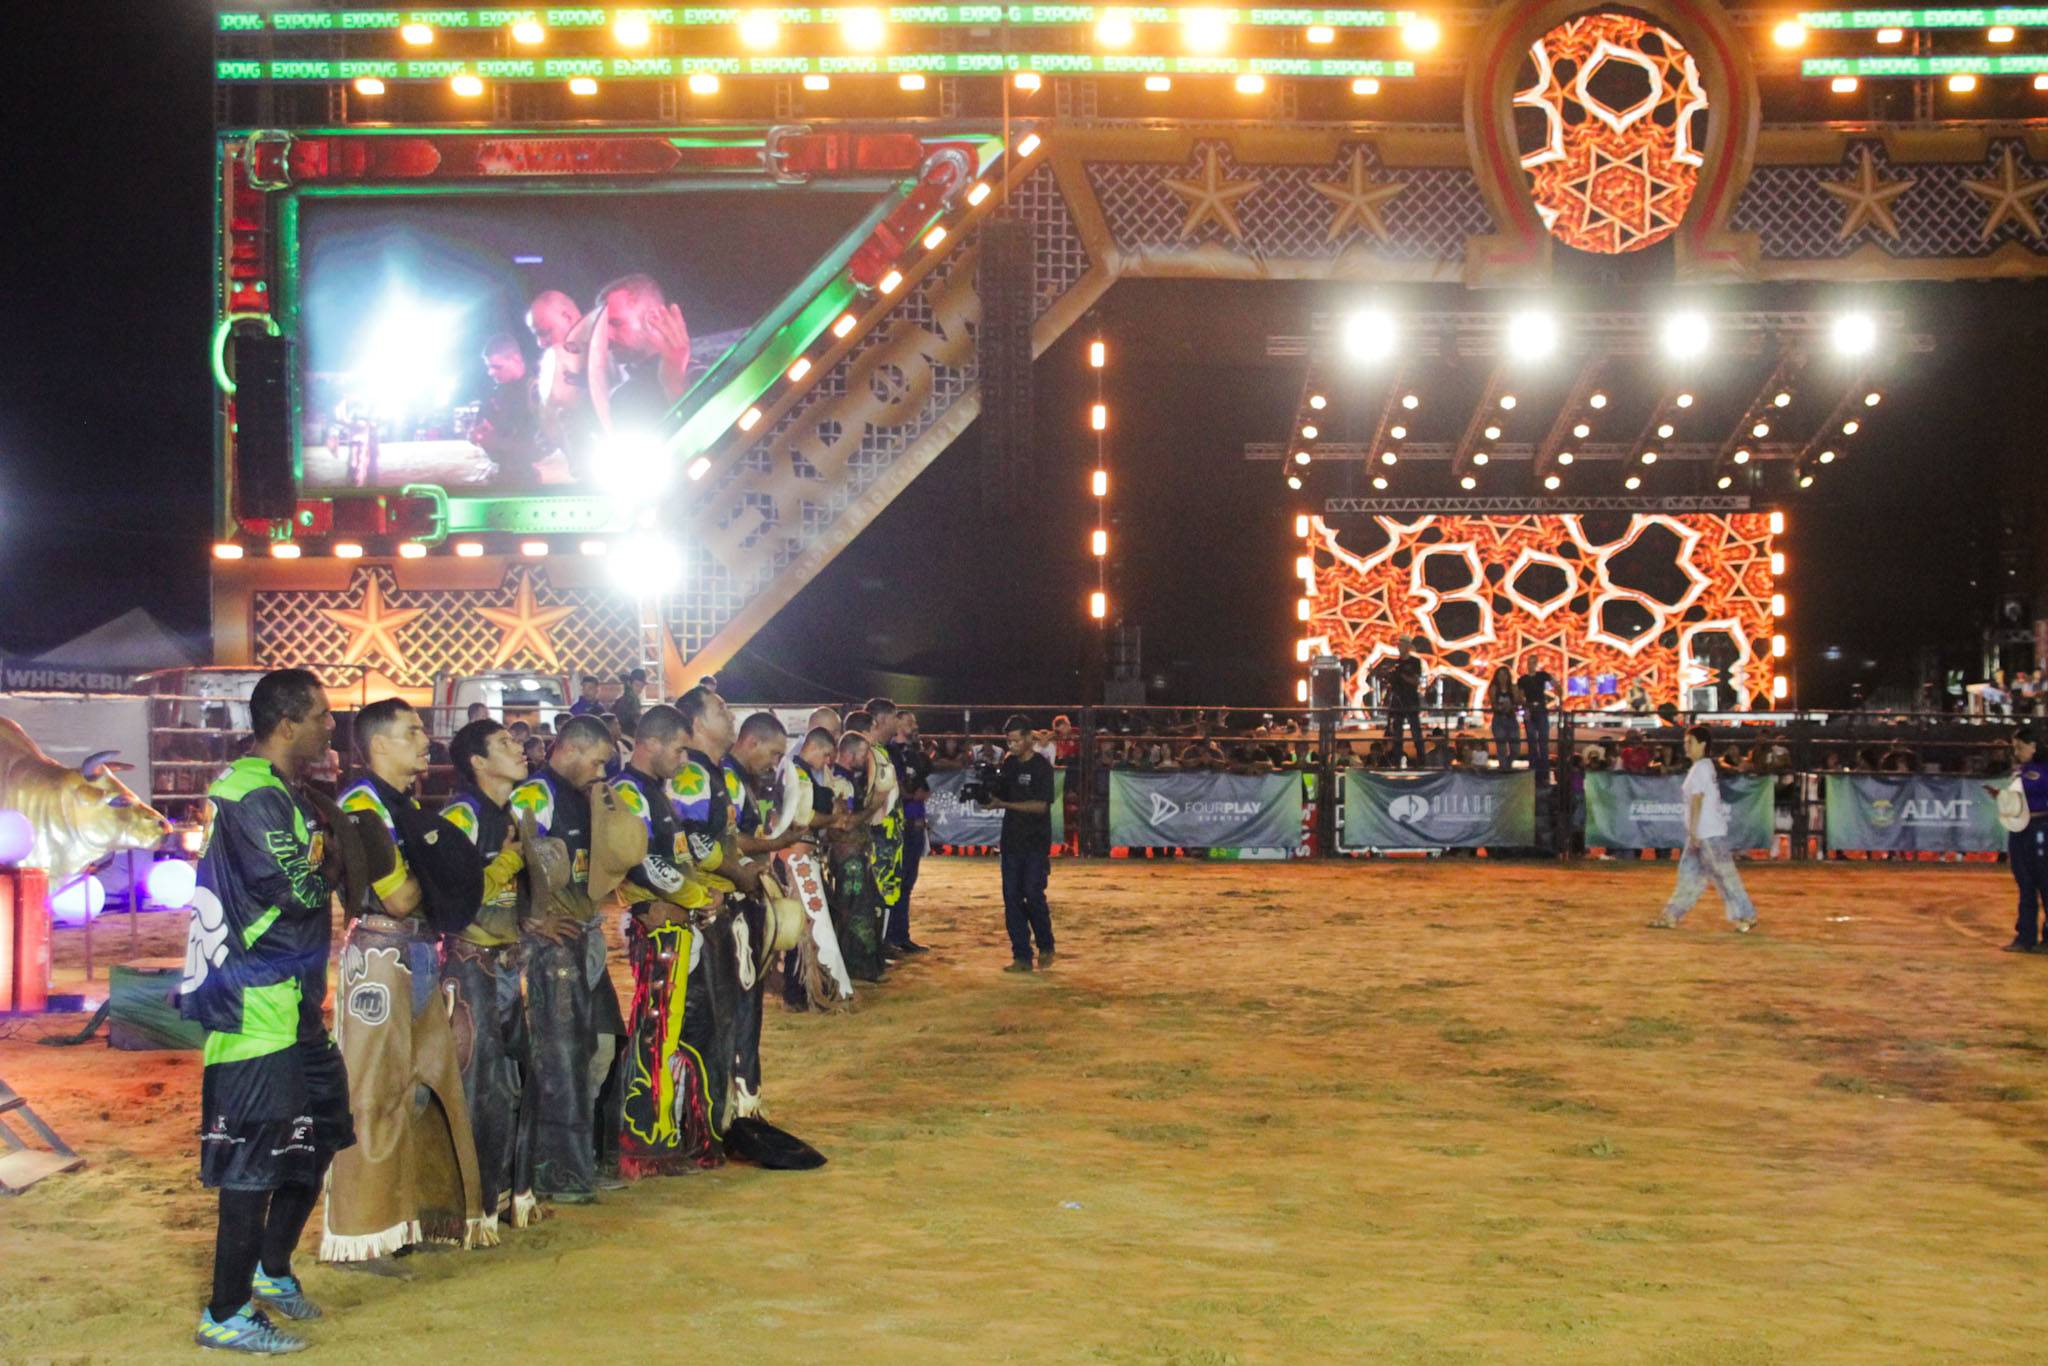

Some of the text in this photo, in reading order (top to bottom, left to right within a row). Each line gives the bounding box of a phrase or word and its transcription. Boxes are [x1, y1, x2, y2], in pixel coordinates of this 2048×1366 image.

[273, 14, 332, 29] EXPOVG
[343, 13, 400, 28] EXPOVG
[548, 10, 606, 25] EXPOVG
[891, 7, 948, 23] EXPOVG
[960, 6, 1021, 22] EXPOG
[1324, 11, 1384, 26] EXPOVG
[272, 63, 329, 78] EXPOVG
[341, 62, 397, 77] EXPOVG
[478, 62, 534, 76] EXPOVG
[546, 61, 603, 76] EXPOVG
[614, 60, 671, 75] EXPOVG
[683, 59, 740, 74] EXPOVG
[751, 58, 808, 73] EXPOVG
[819, 57, 877, 72] EXPOVG
[888, 56, 946, 71] EXPOVG
[1031, 55, 1092, 70] EXPOVG
[1104, 56, 1165, 71] EXPOVG
[1250, 59, 1311, 74] EXPOVG
[1323, 60, 1383, 75] EXPOVG
[1184, 802, 1261, 814] FOURPLAY
[1902, 800, 1973, 819] ALMT
